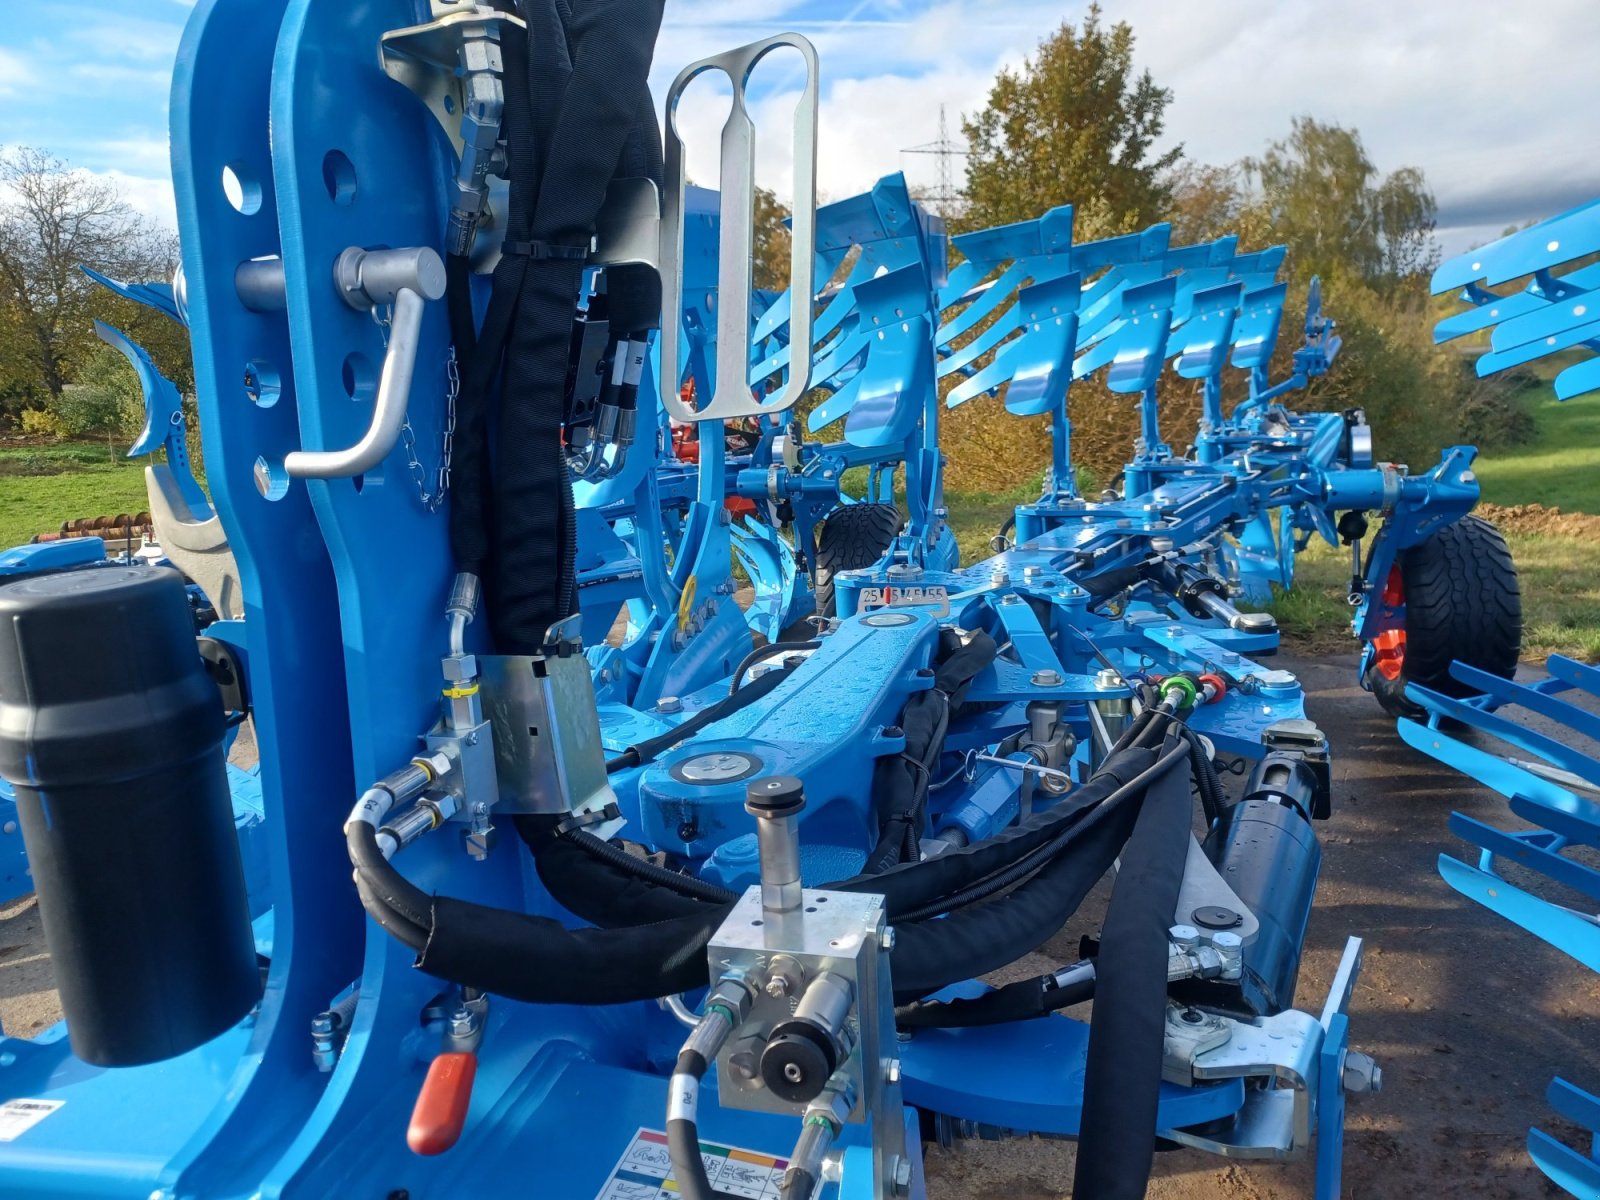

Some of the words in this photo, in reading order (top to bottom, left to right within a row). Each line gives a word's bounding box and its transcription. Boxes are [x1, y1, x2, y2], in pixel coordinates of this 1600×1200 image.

[863, 589, 878, 603] 25
[928, 588, 943, 601] 55
[363, 799, 378, 812] P3
